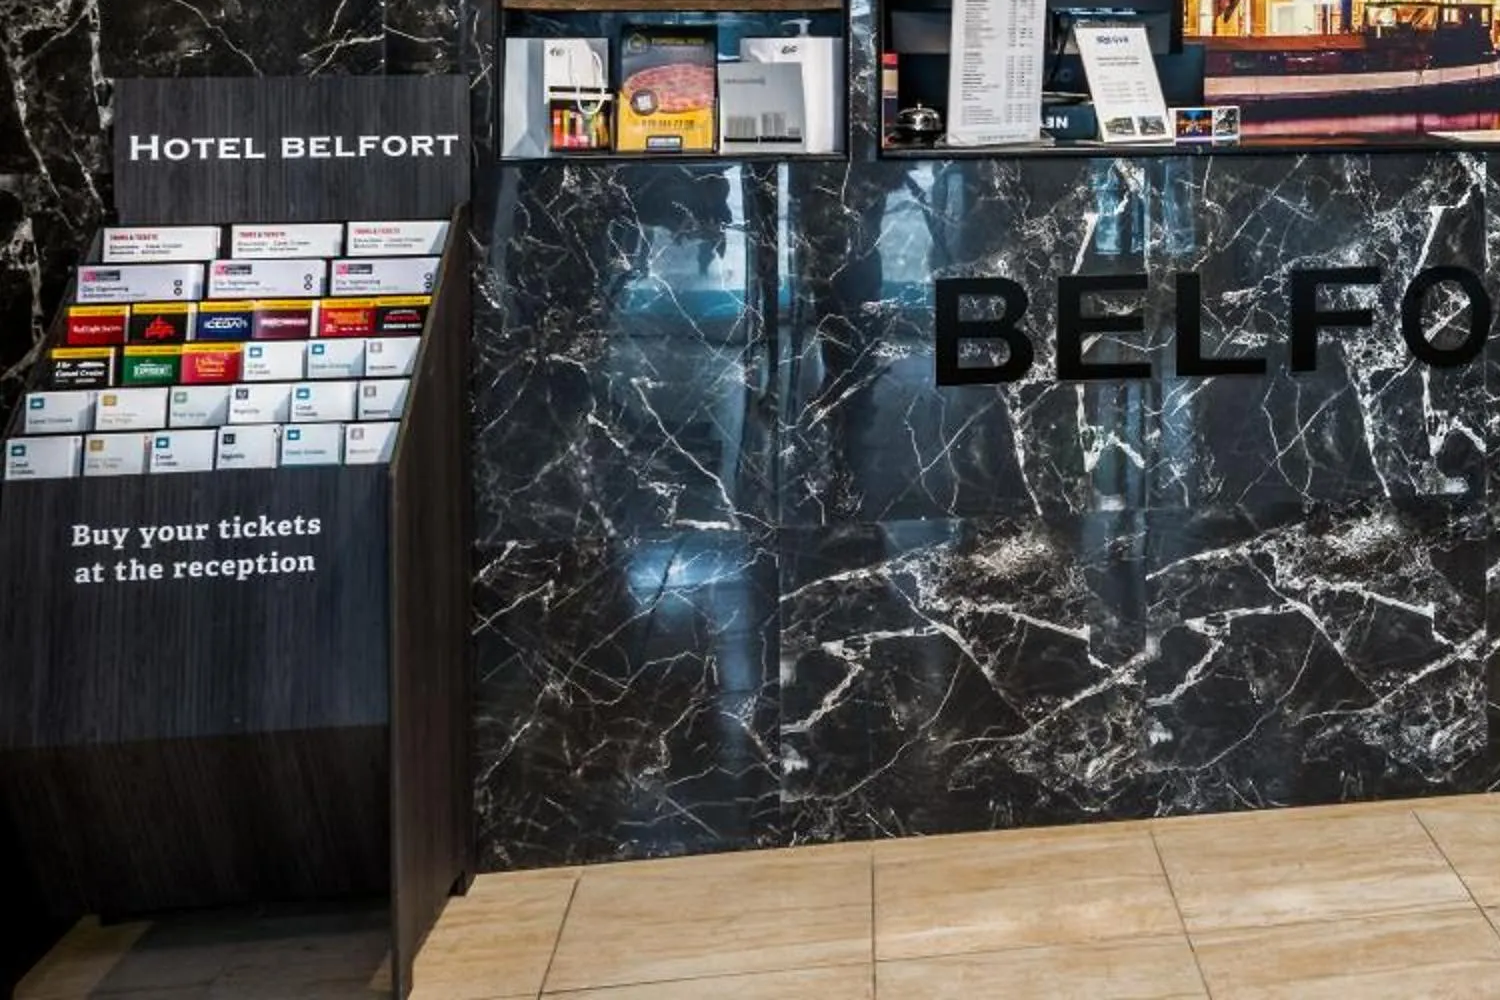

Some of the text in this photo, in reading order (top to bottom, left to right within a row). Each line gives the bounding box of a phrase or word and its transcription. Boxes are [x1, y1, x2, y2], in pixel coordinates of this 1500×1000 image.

[129, 134, 459, 161] HOTEL BELFORT
[71, 514, 321, 551] Buy your tickets
[74, 551, 316, 584] at the reception
